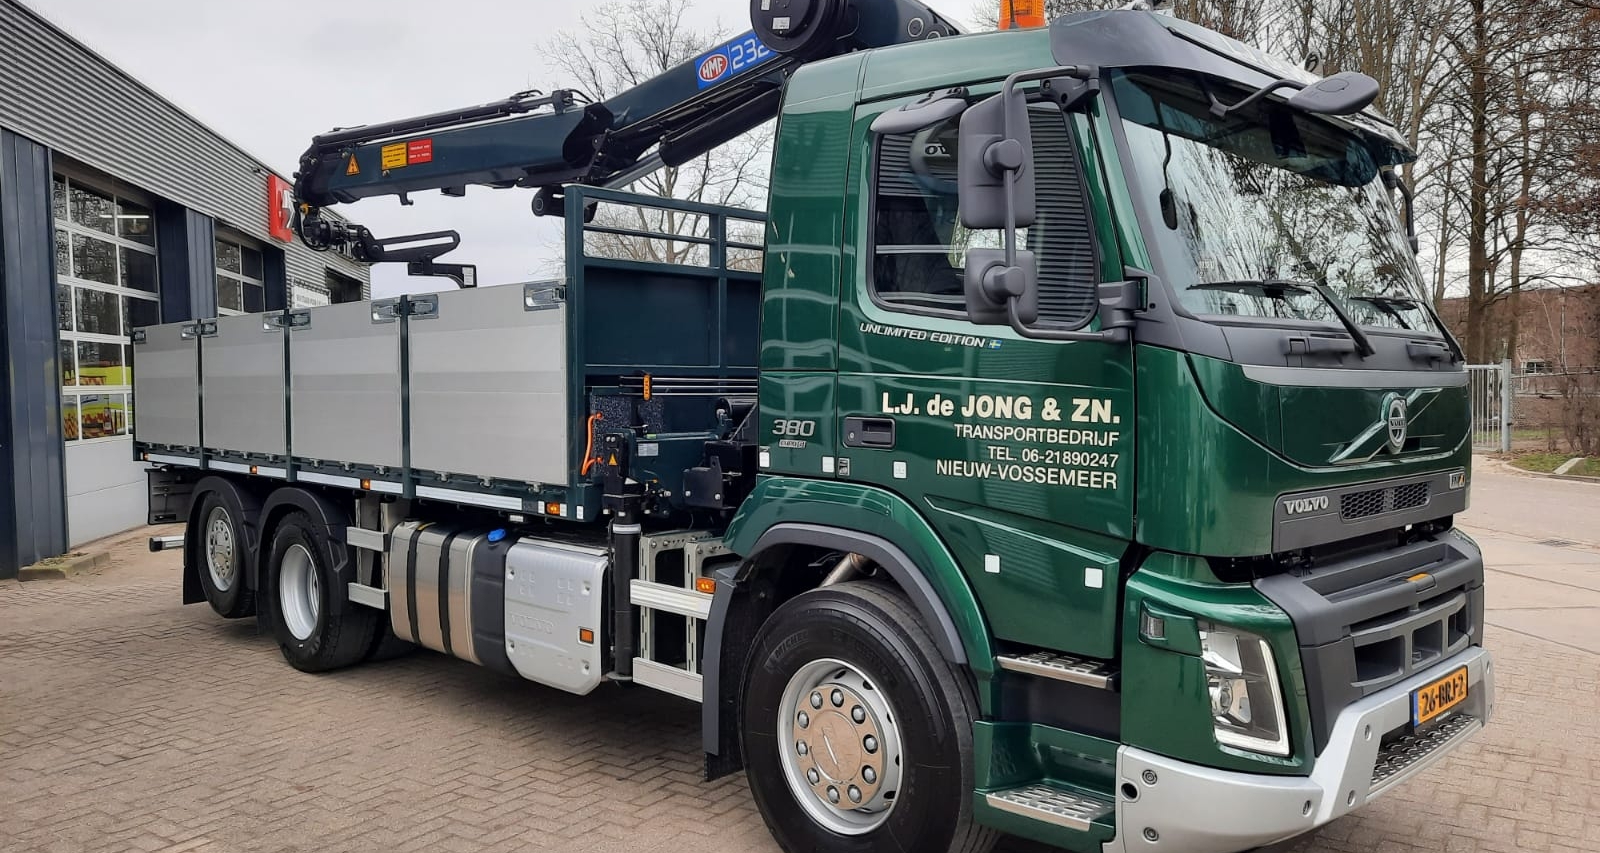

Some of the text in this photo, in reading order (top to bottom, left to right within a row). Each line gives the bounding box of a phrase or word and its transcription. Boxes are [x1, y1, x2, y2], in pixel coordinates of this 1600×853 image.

[702, 57, 723, 79] HMF
[860, 322, 986, 348] UNLIMITED EDITION
[882, 392, 1121, 424] L.J. de JONG & ZN.
[772, 419, 816, 437] 380
[954, 424, 1120, 447] TRANSPORTBEDRIJF
[988, 446, 1120, 468] TEL. 06-21890247
[936, 459, 1118, 490] NIEUW-VOSSEMEER
[1283, 495, 1330, 515] VOLVO
